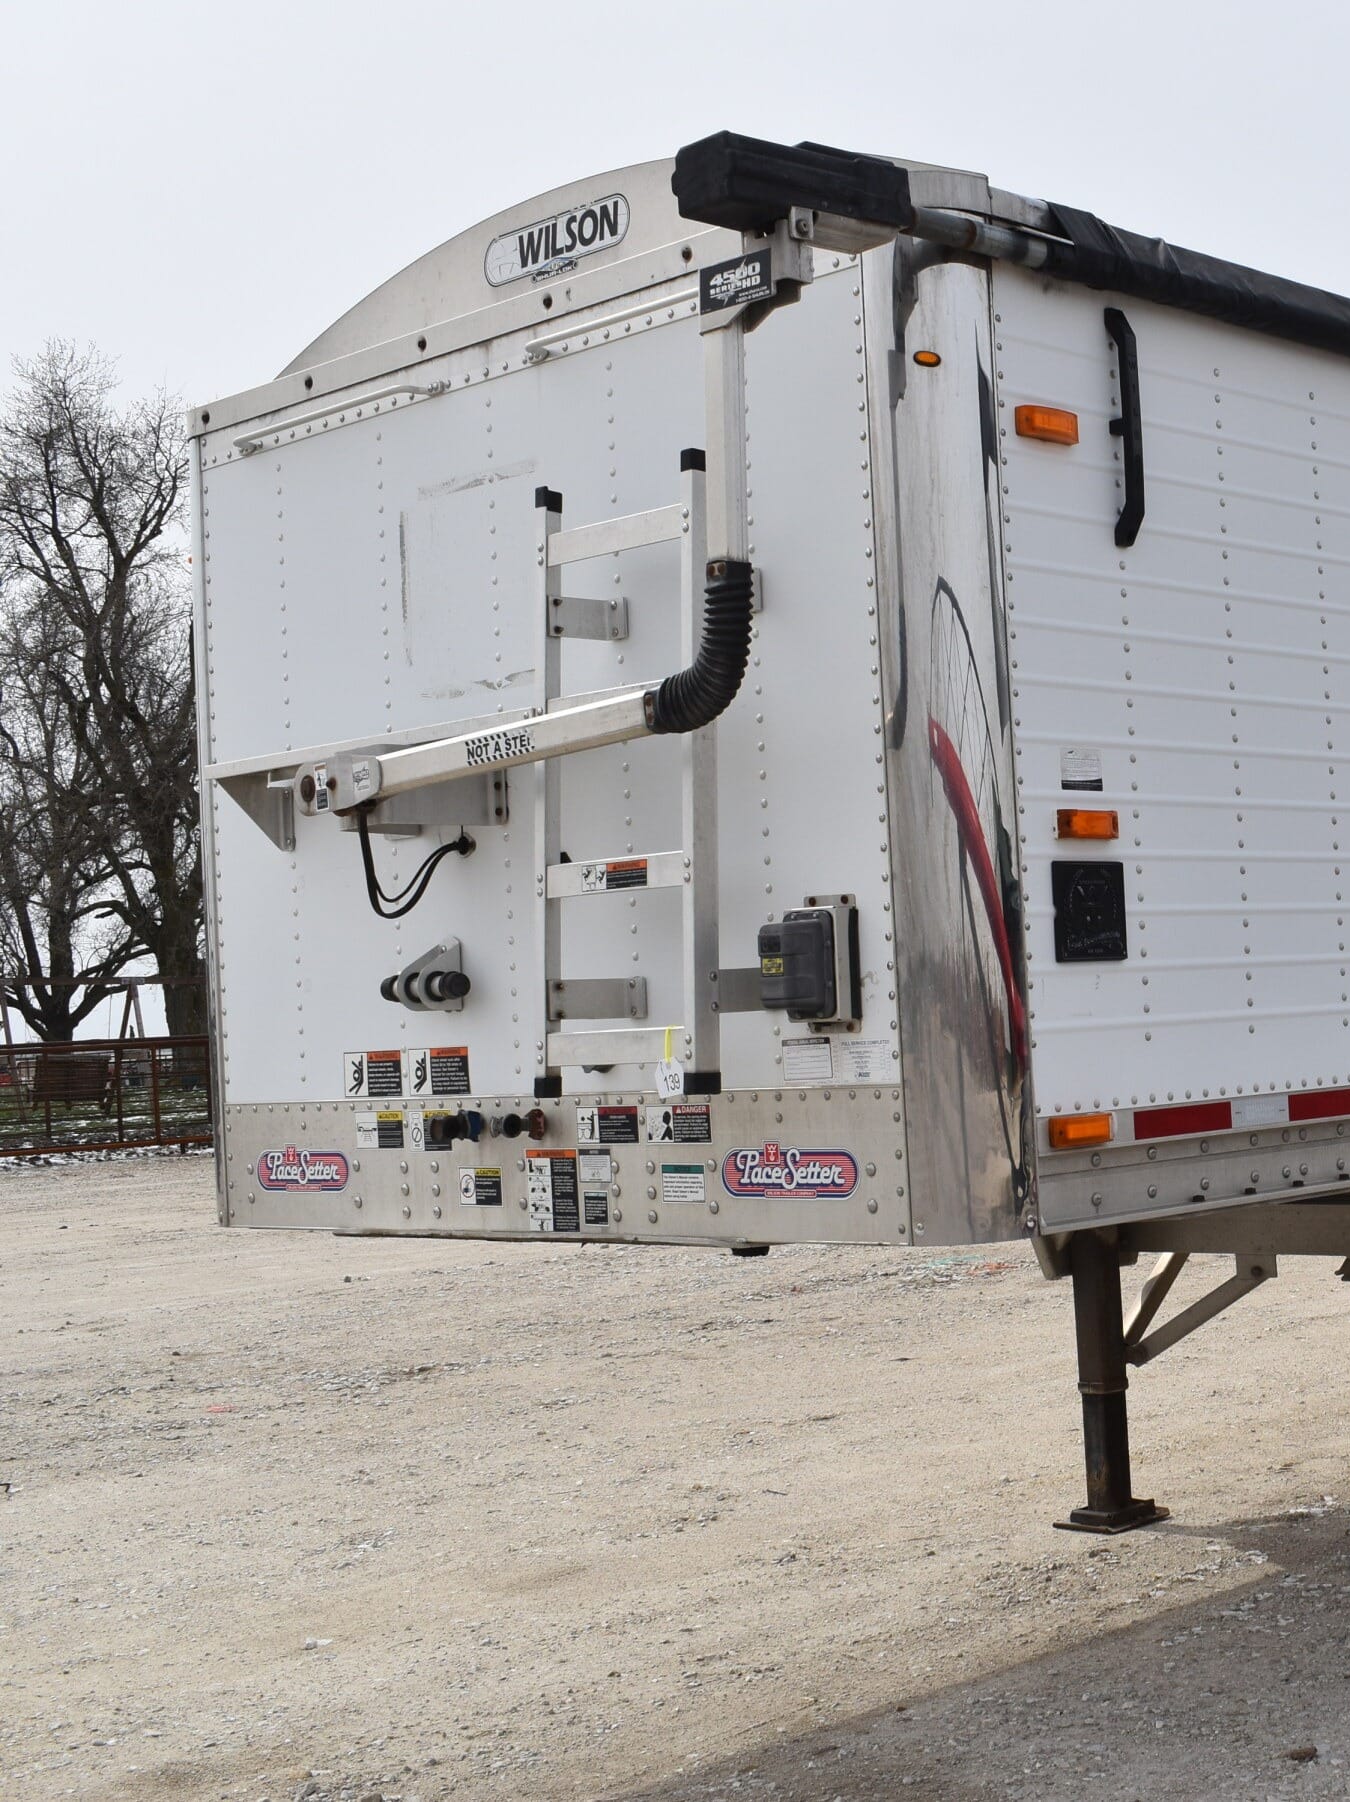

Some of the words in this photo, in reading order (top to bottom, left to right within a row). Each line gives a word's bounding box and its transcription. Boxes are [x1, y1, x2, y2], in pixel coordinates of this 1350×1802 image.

[517, 199, 620, 269] WILSON
[709, 261, 761, 287] 4500
[467, 743, 490, 760] NOT
[494, 740, 502, 754] A
[663, 1073, 681, 1092] 139
[681, 1105, 707, 1113] DANGER
